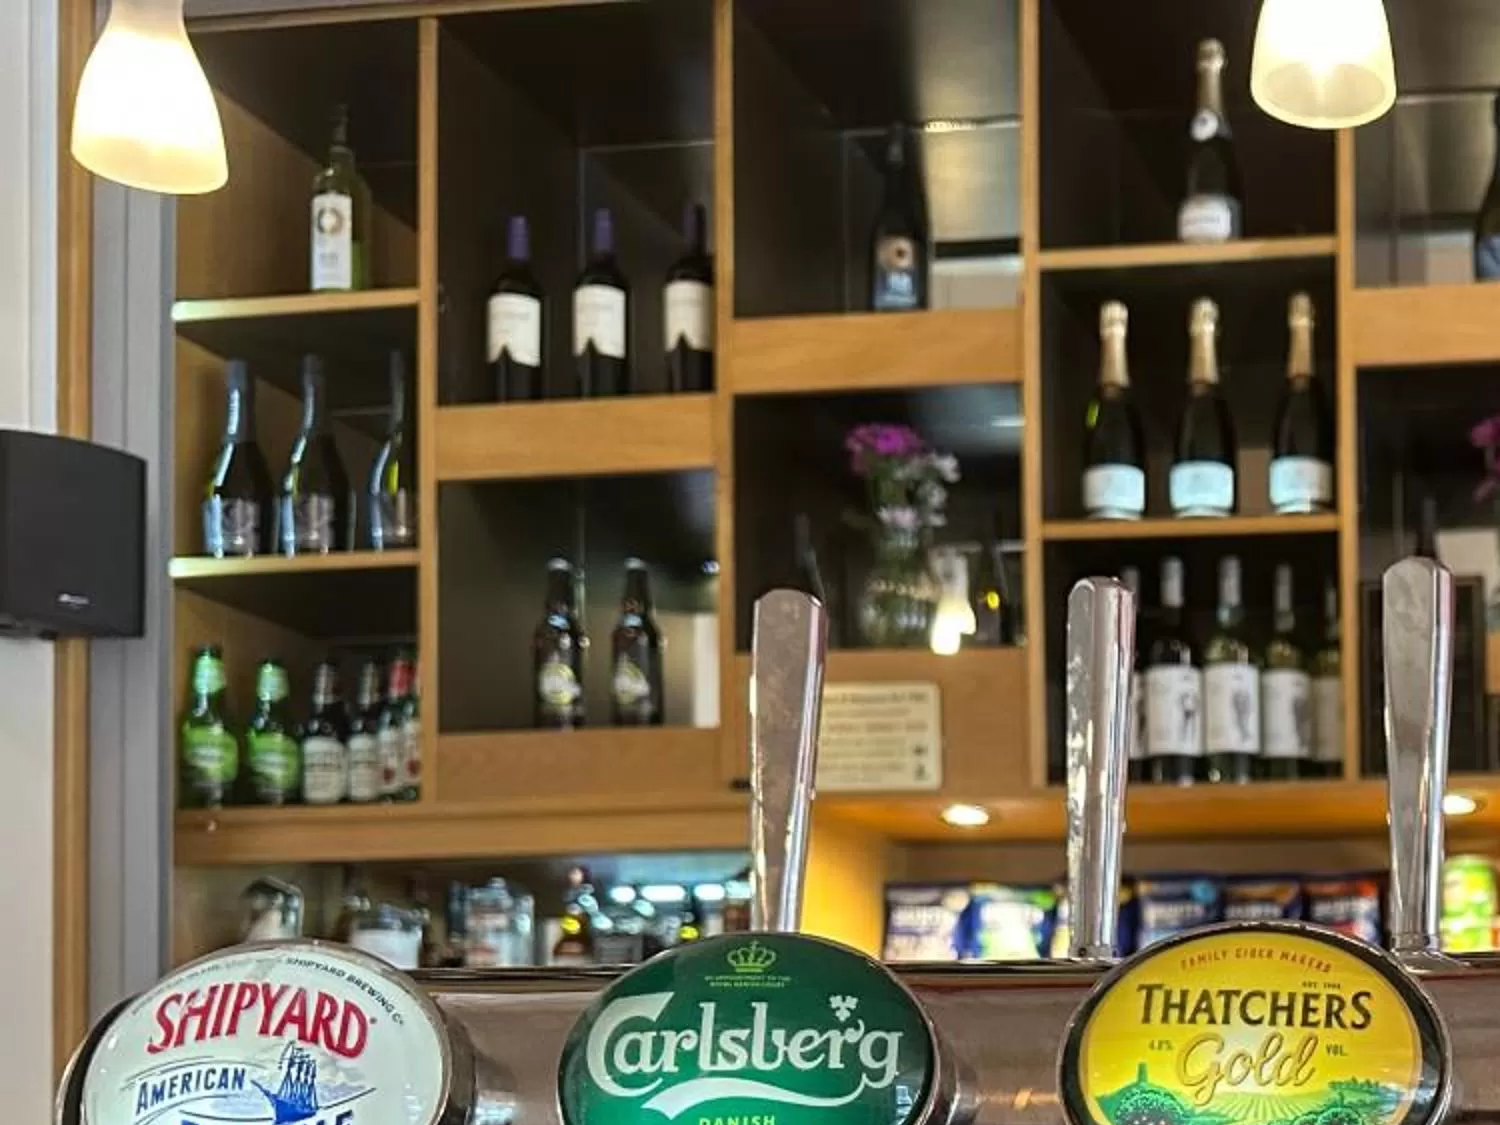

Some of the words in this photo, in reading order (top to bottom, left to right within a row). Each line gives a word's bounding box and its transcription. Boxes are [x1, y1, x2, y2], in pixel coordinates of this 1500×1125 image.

[286, 957, 346, 978] SHIPYARD
[346, 974, 395, 1014] BREWING
[1136, 983, 1372, 1030] THATCHERS
[147, 981, 370, 1059] SHIPYARD
[586, 991, 904, 1098] Carlsberg
[135, 1067, 246, 1116] AMERICAN
[1175, 1031, 1319, 1106] Gold
